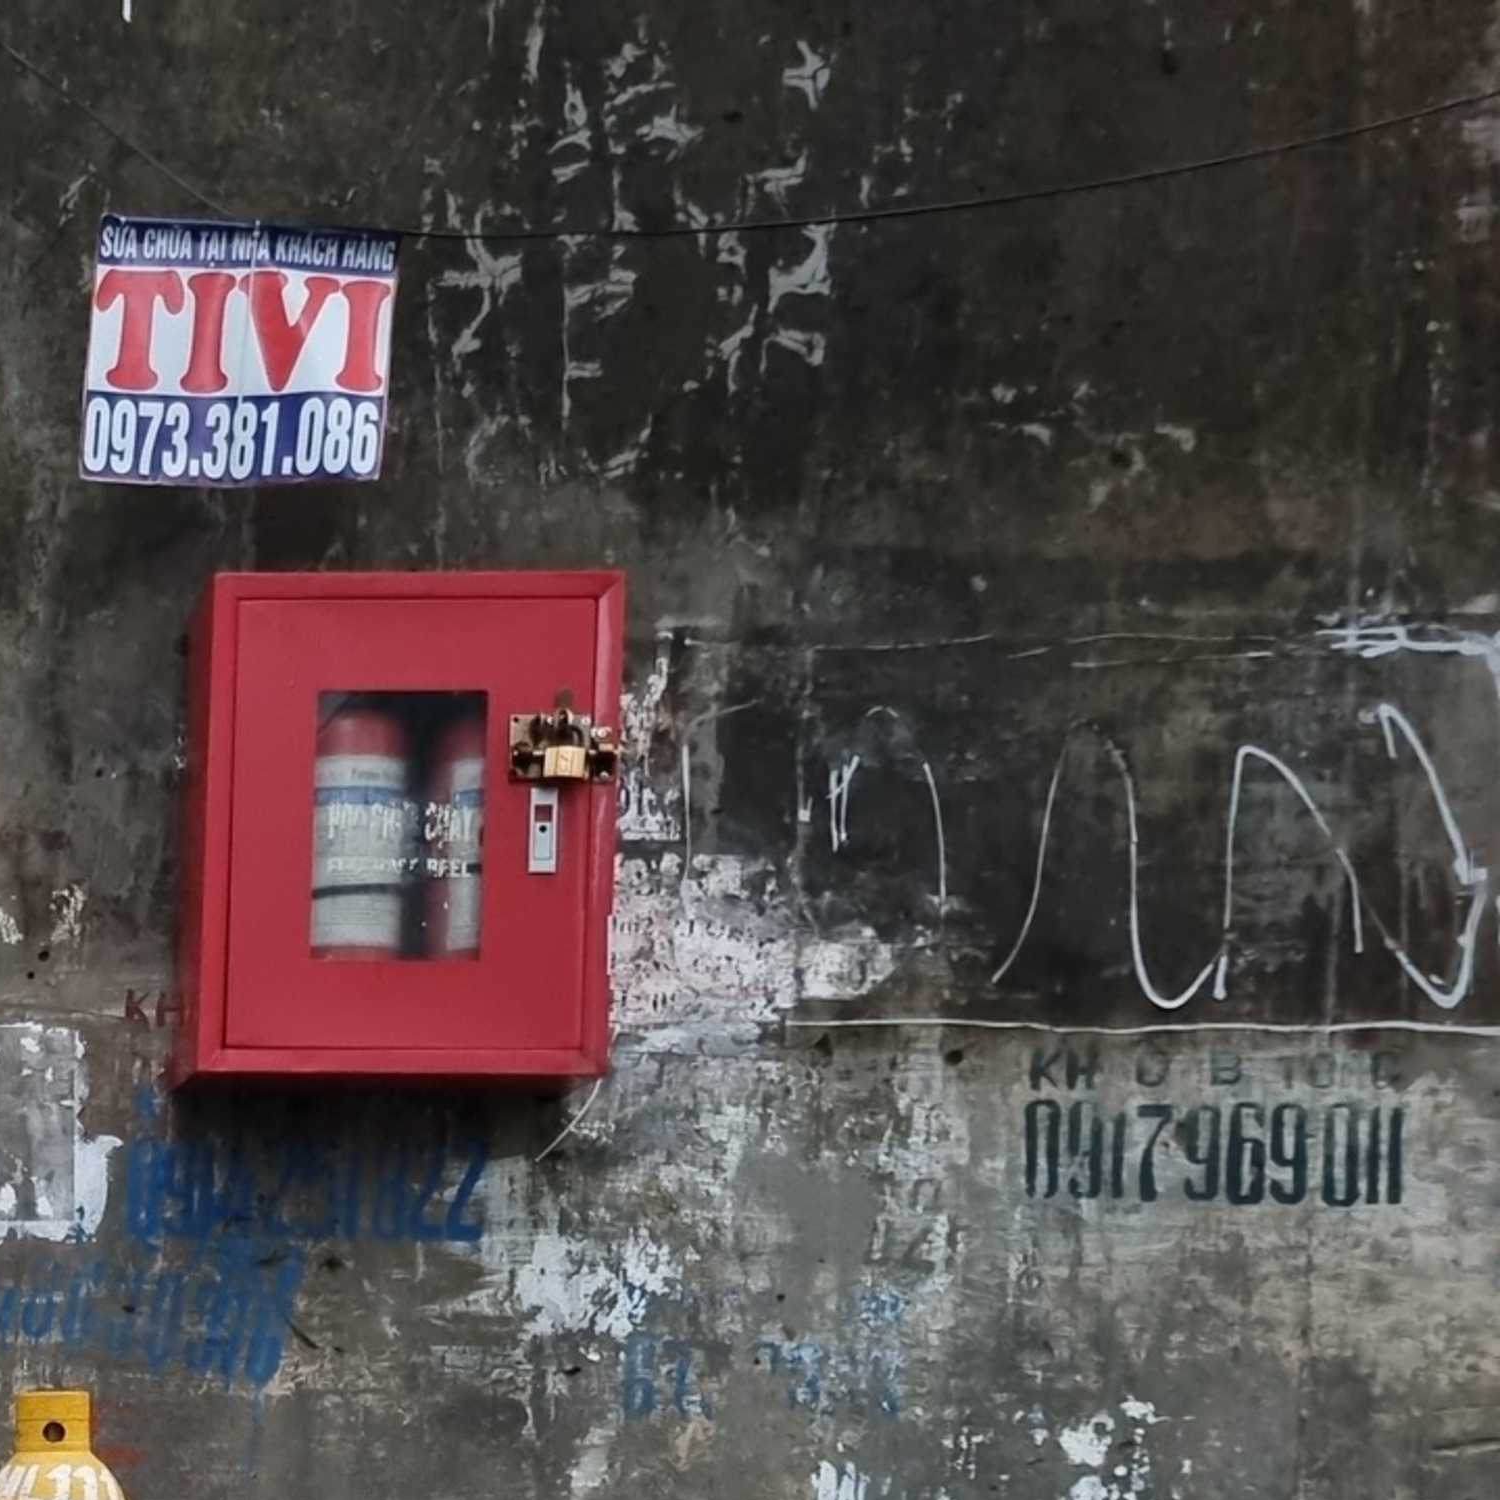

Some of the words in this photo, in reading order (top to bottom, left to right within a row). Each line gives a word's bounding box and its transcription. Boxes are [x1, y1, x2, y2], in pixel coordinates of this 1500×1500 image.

[200, 230, 227, 267] TẠI
[96, 268, 391, 394] TIVI
[83, 397, 380, 481] 0973.381.086
